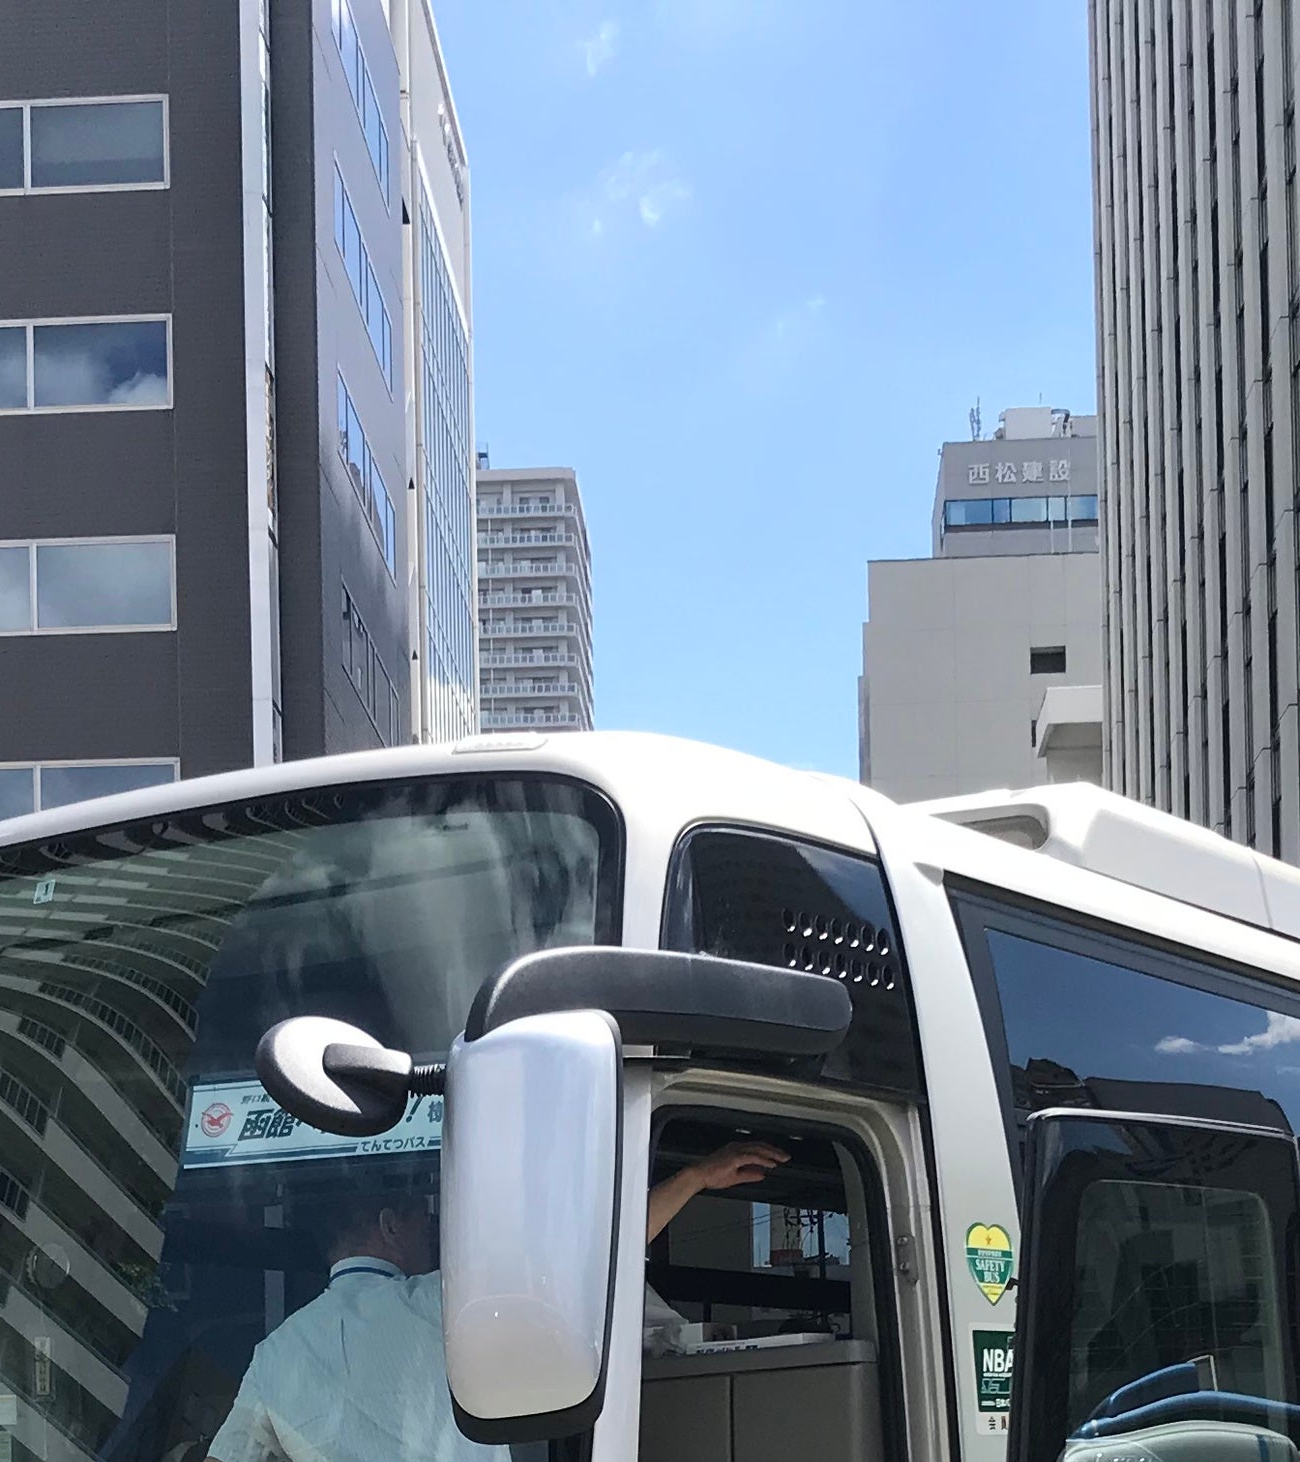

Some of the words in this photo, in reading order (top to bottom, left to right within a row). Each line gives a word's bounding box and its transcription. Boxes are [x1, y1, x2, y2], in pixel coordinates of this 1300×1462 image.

[968, 459, 1070, 485] 西松建設
[238, 1108, 300, 1141] 函館
[361, 1135, 426, 1153] てんてつバス
[975, 1258, 1006, 1273] SAFETY
[983, 1271, 1001, 1283] BUS
[982, 1348, 1014, 1373] NBA
